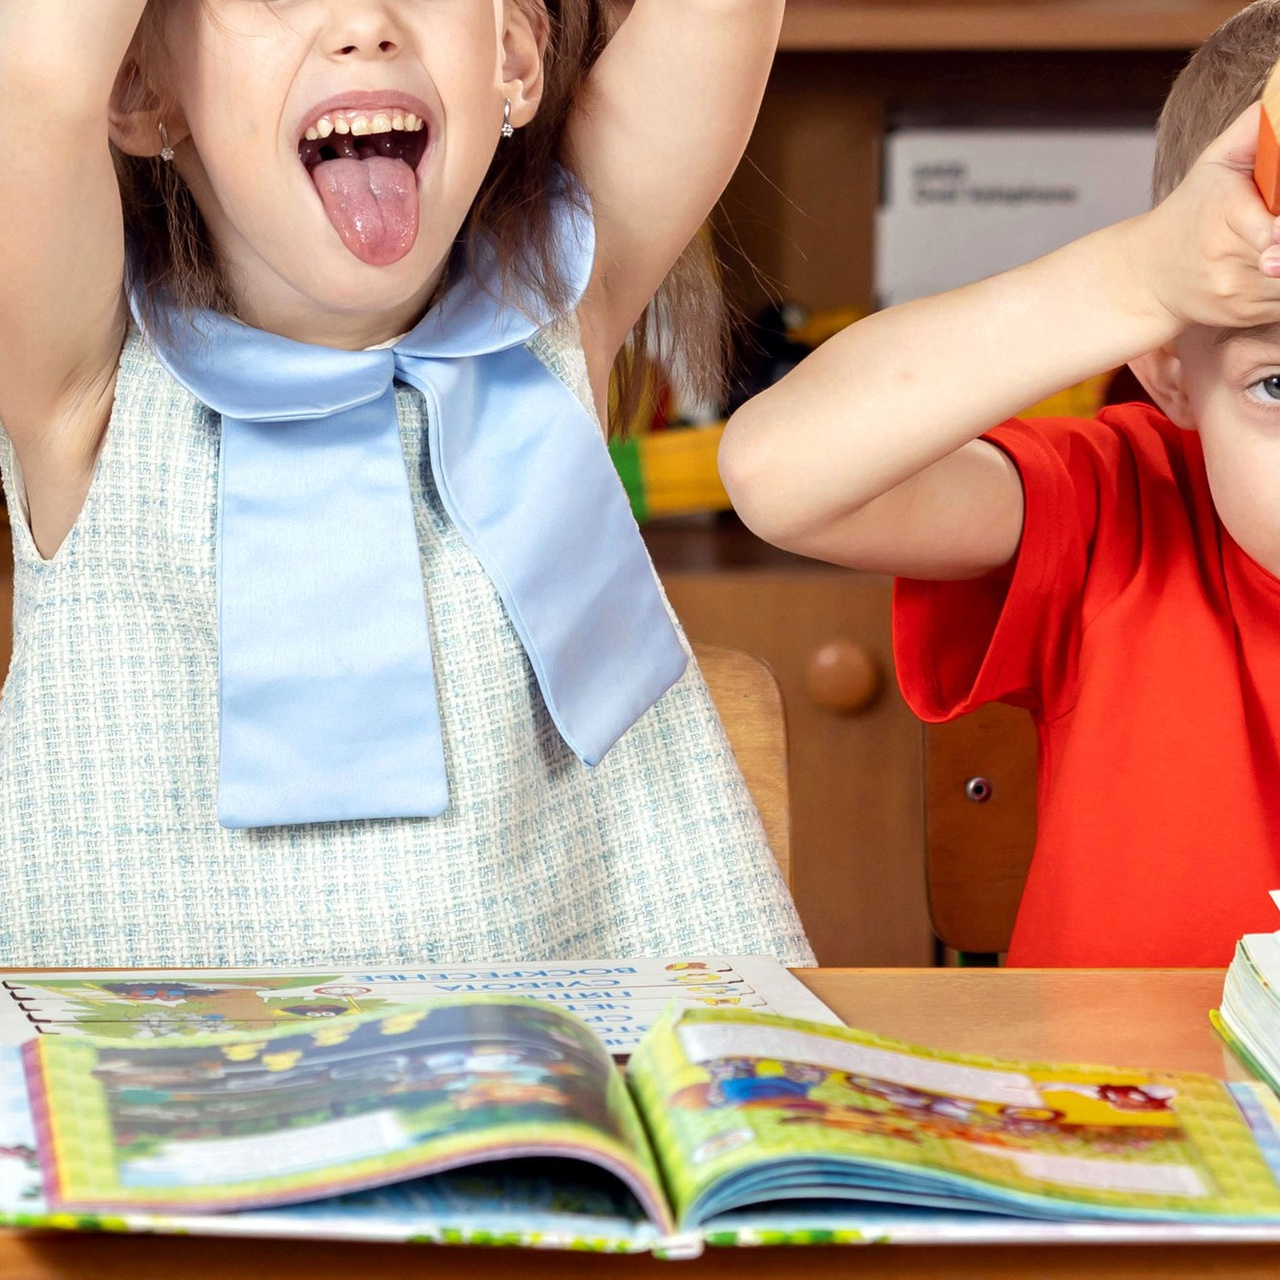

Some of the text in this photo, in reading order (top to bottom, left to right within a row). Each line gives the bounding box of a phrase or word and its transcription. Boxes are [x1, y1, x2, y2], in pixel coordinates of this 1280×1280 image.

[352, 966, 638, 982] ВОСКРЕСЕНЬЕ
[433, 979, 620, 991] СУББОТА
[519, 990, 633, 1000] ПЯТН
